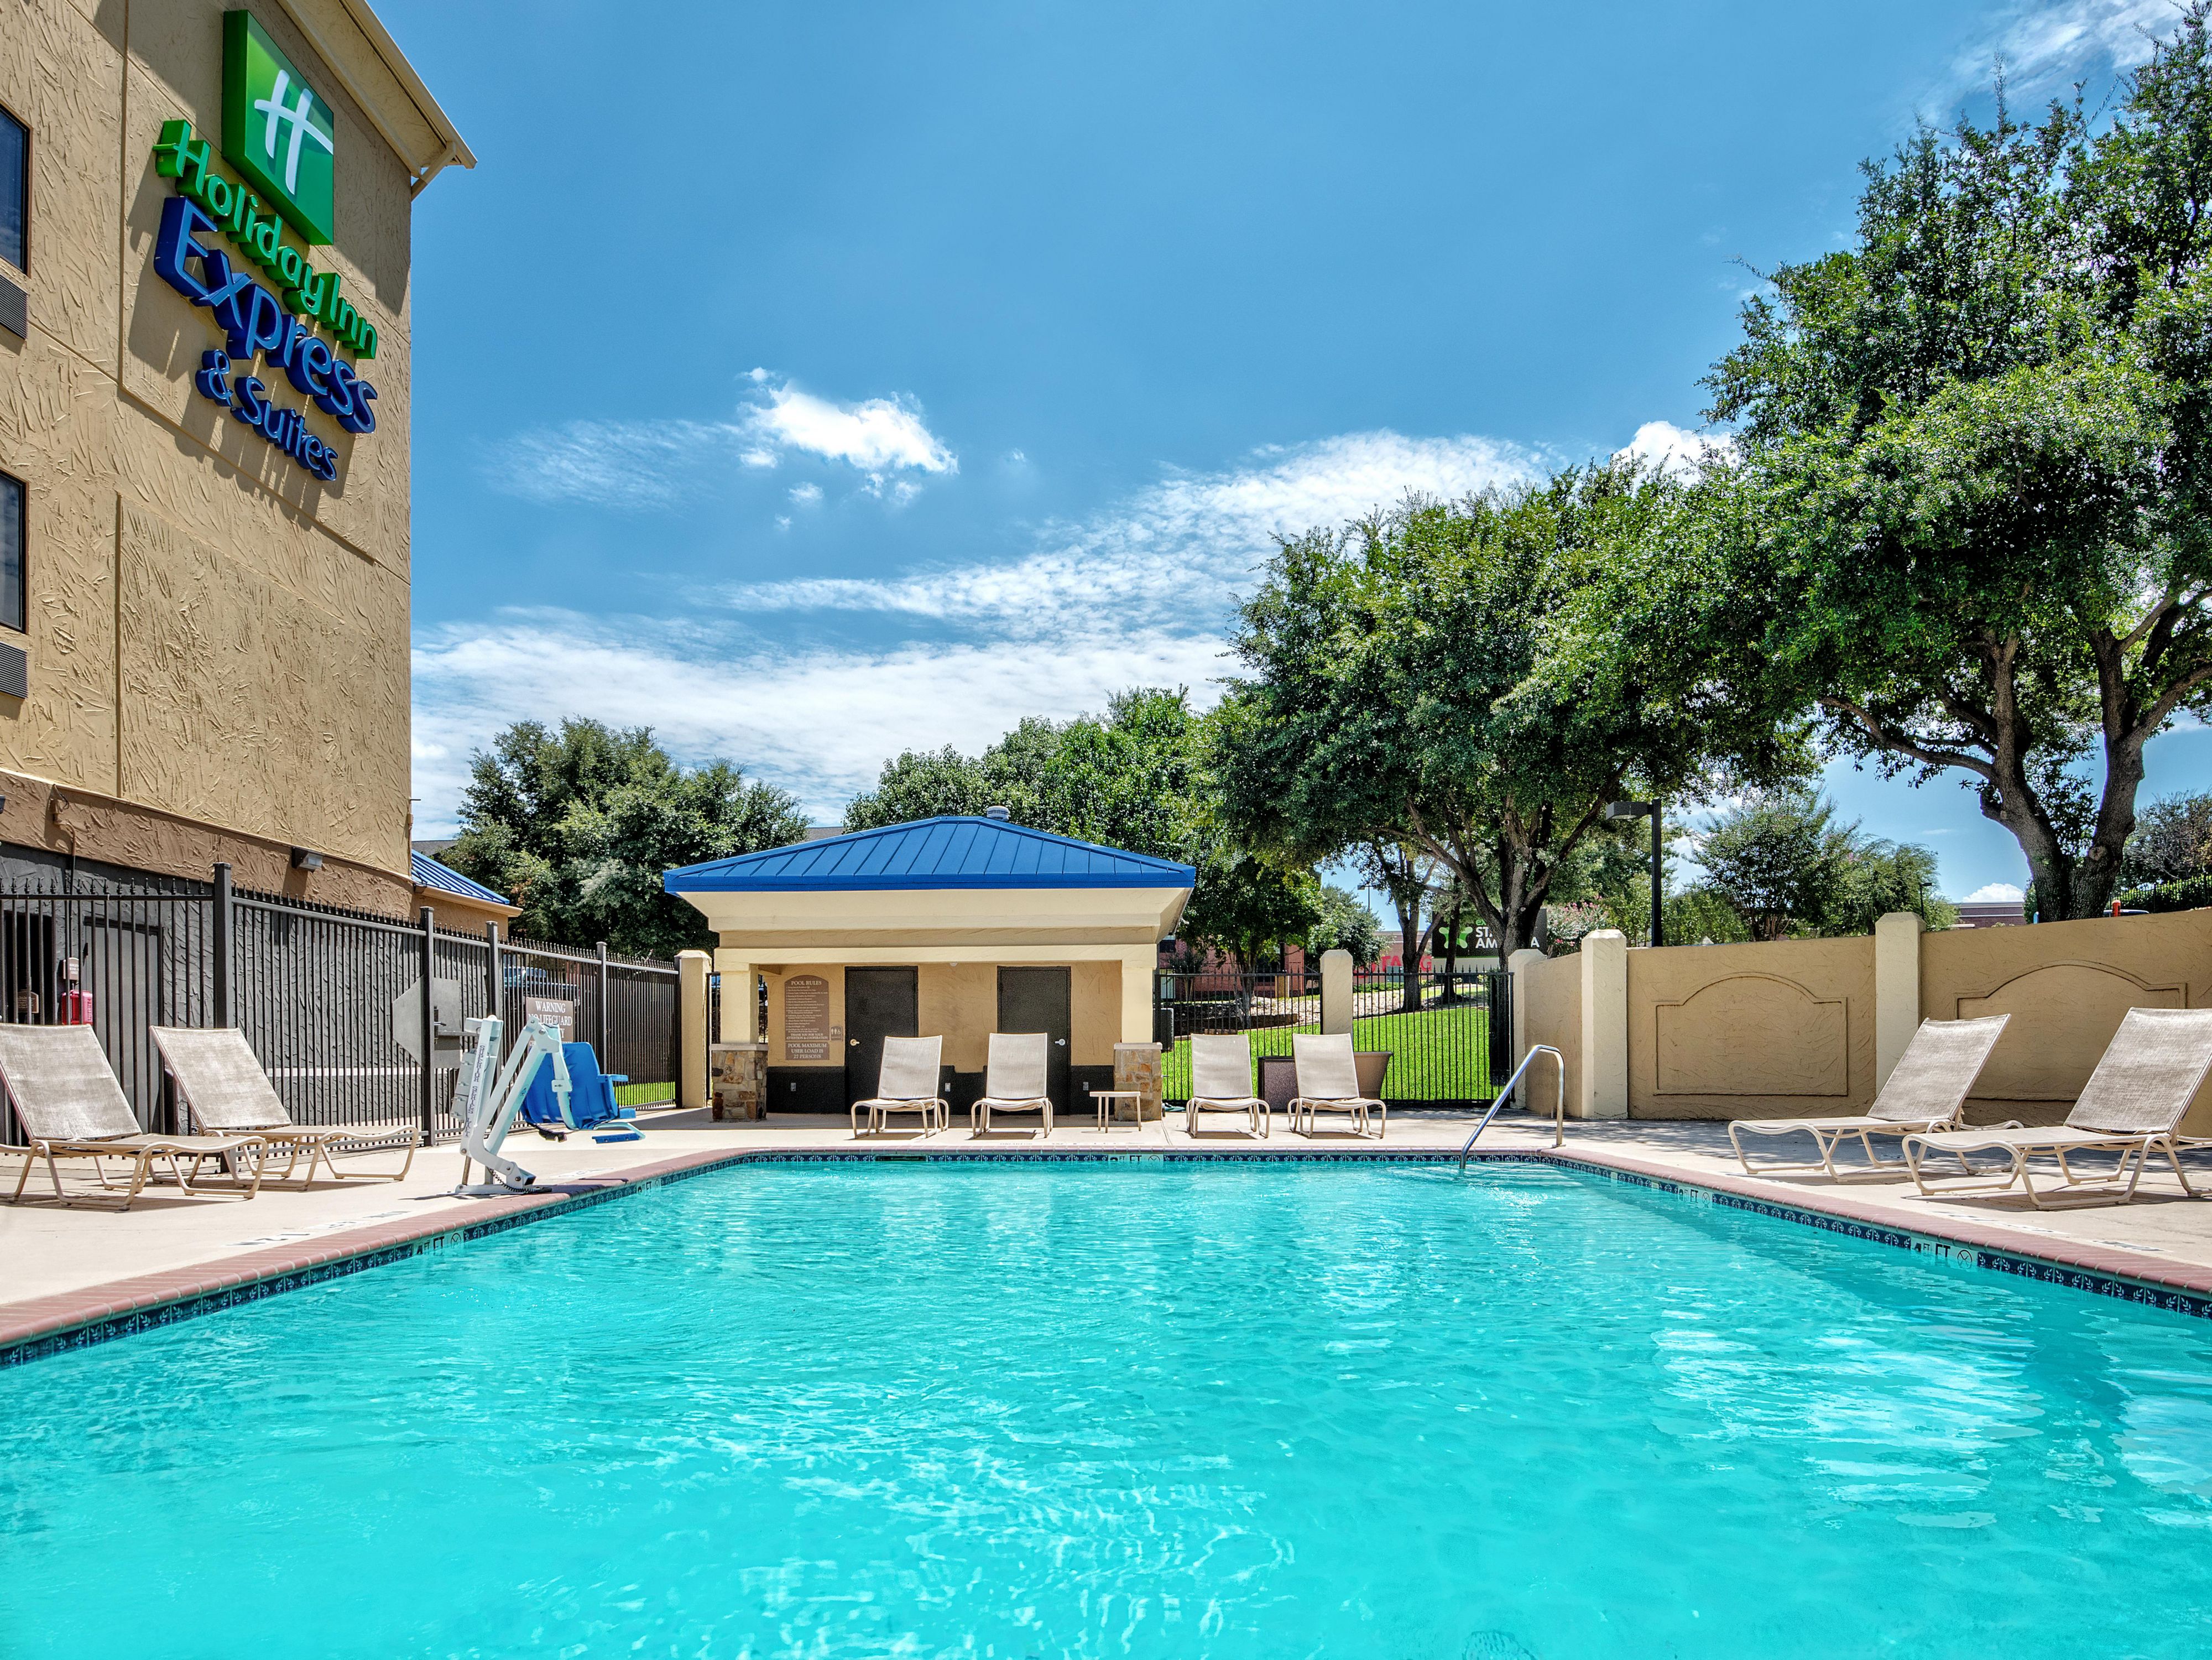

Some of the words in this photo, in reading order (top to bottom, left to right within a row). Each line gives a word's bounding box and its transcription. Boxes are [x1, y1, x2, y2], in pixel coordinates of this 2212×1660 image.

[153, 119, 325, 315] Holiday
[322, 273, 378, 360] Inn
[154, 196, 378, 434] Express
[195, 349, 234, 407] &
[230, 376, 339, 481] Suites
[535, 1001, 566, 1013] WARNING
[540, 1014, 572, 1026] LIFEGUARD
